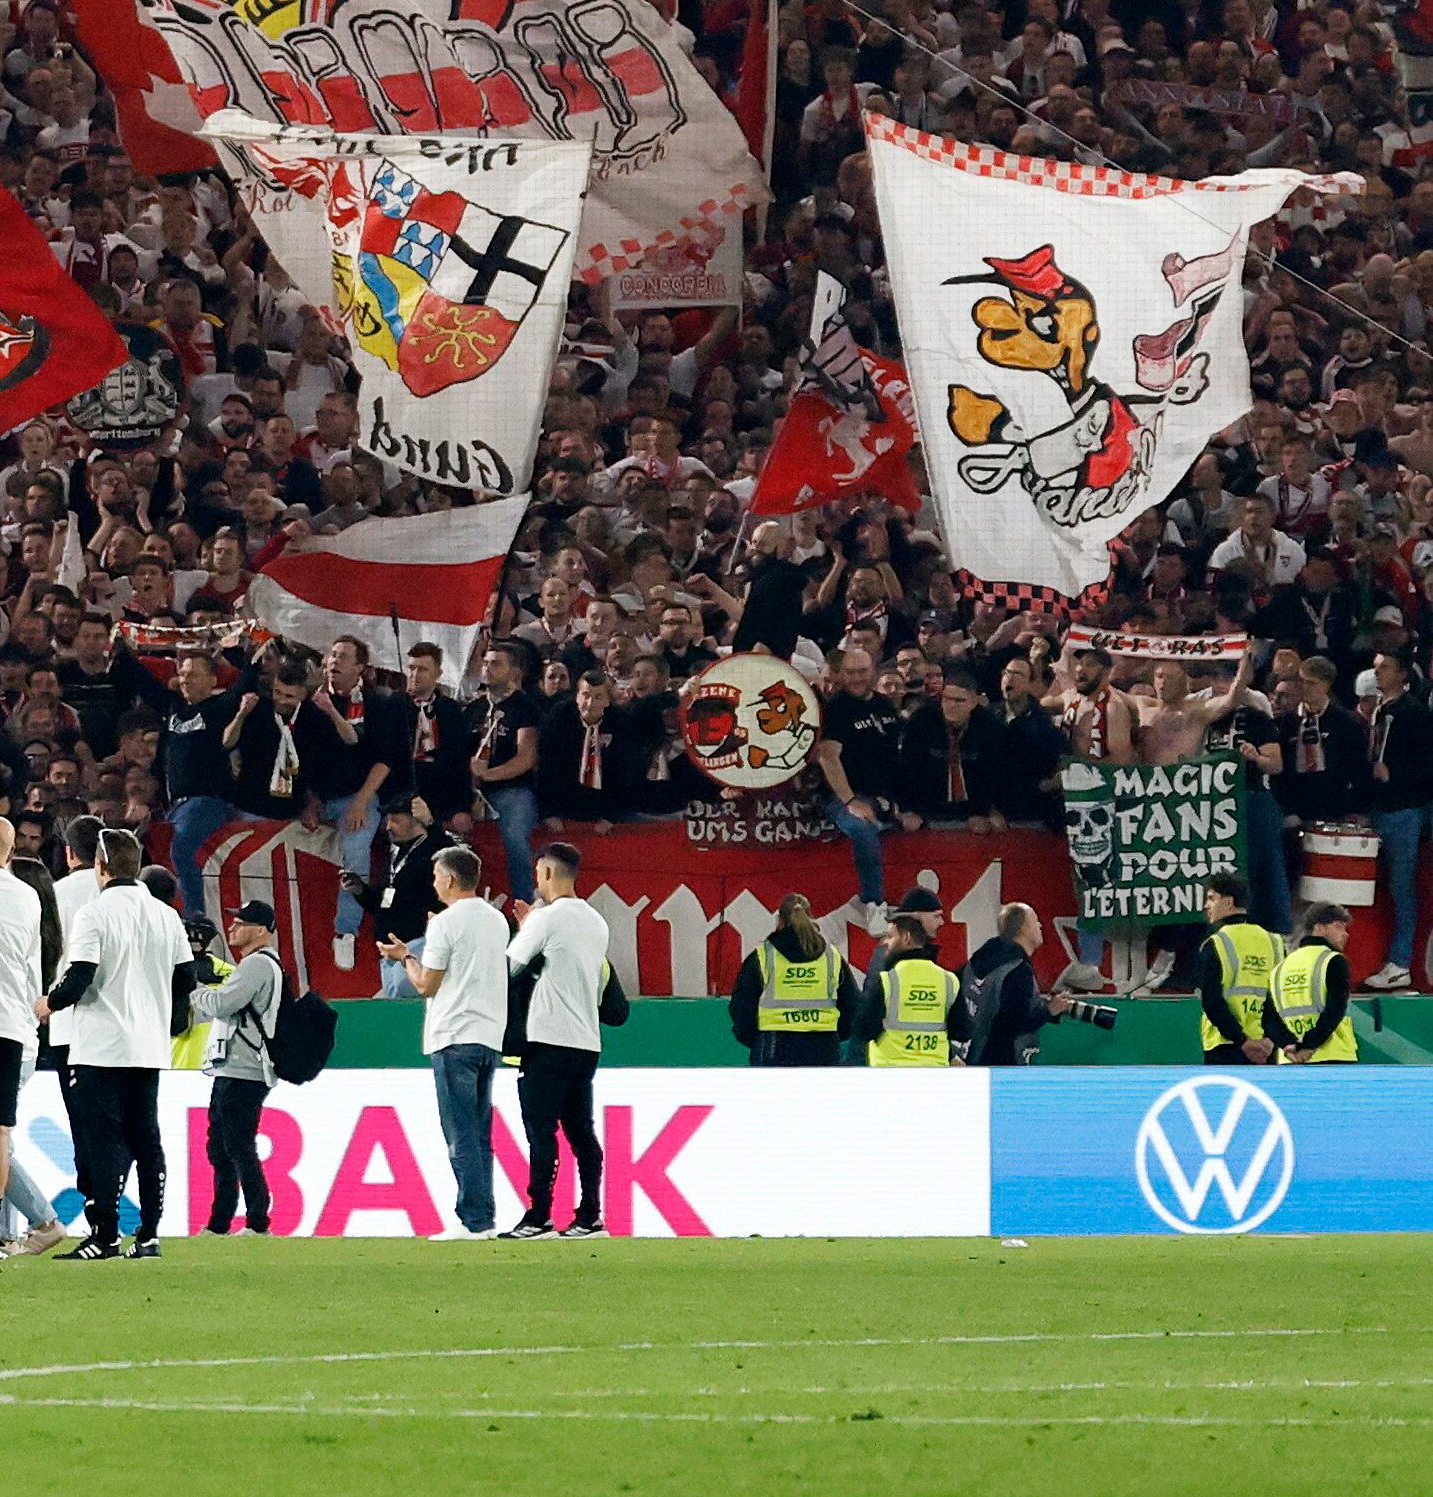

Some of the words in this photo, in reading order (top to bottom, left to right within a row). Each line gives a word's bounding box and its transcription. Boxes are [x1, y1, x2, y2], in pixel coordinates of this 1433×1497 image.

[1112, 762, 1239, 798] MAGIC
[1114, 798, 1238, 846] FANS
[1119, 845, 1238, 881] POUR
[785, 966, 817, 979] SDS
[908, 990, 938, 1001] SDS
[905, 1034, 939, 1051] 2138
